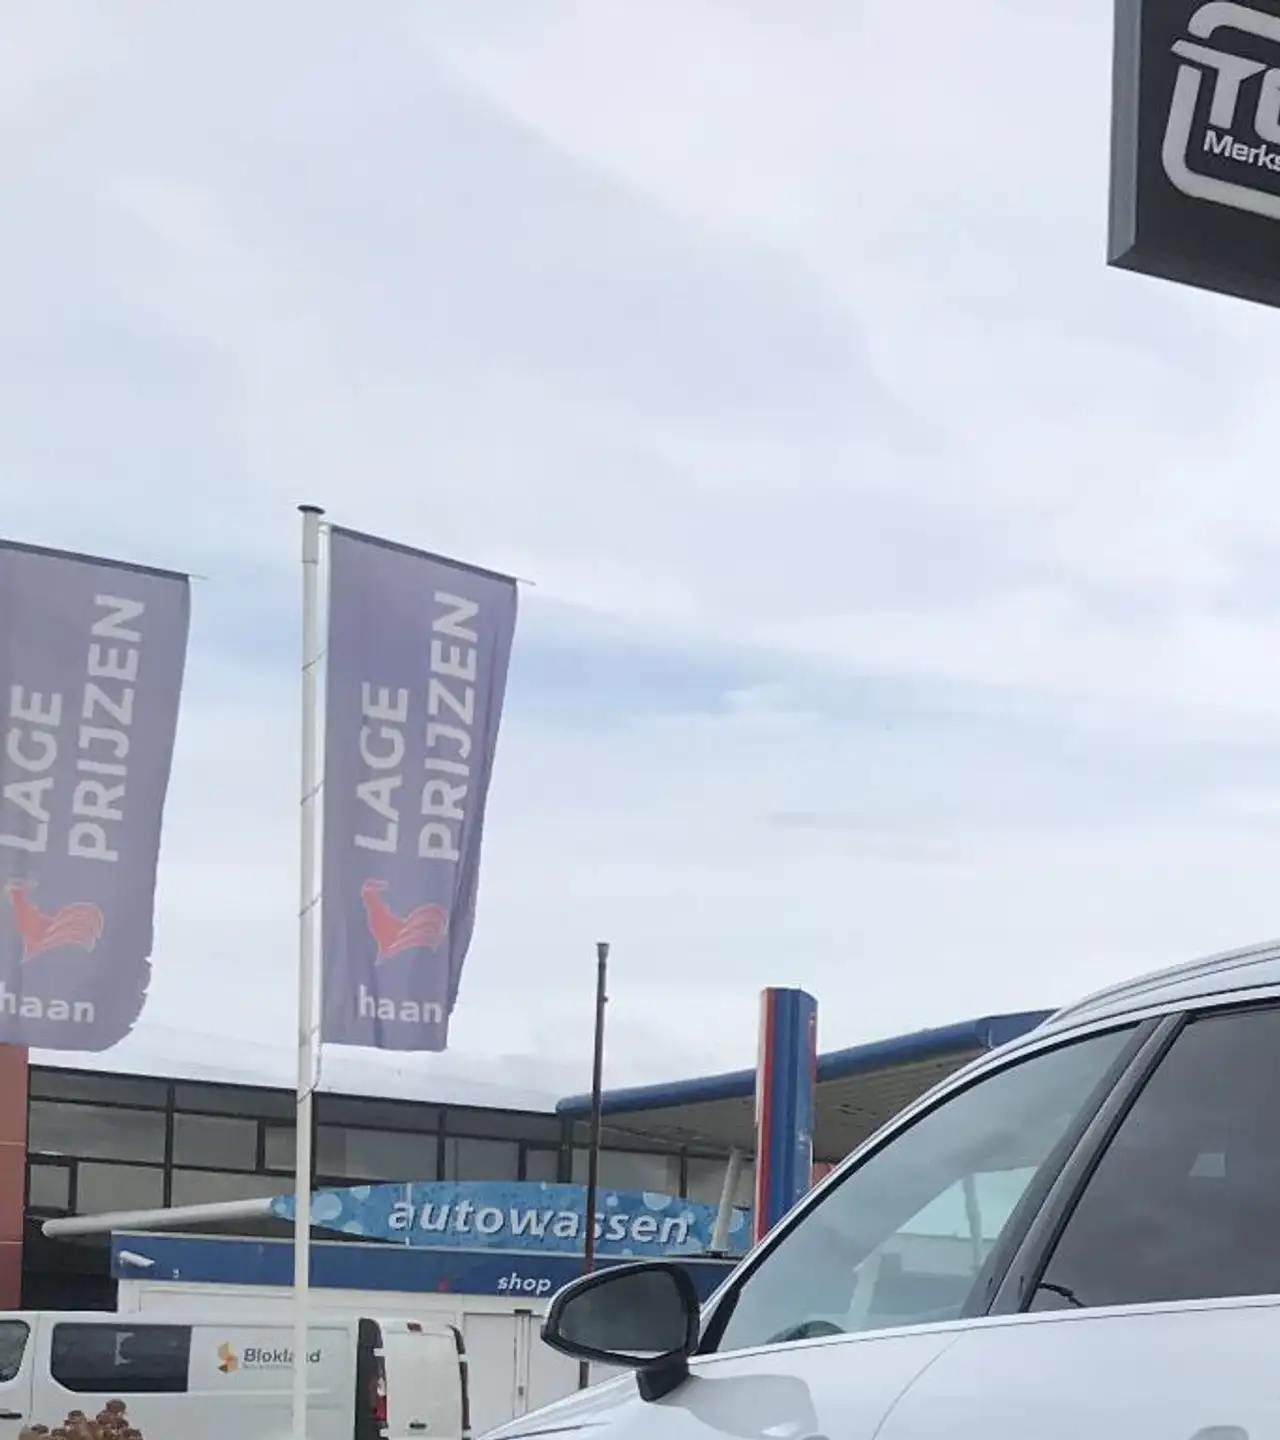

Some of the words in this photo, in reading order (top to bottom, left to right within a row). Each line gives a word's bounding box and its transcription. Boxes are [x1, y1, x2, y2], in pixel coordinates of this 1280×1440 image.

[0, 684, 63, 853] LAGE
[68, 594, 145, 863] PRIJZEN
[354, 681, 409, 854] LAGE
[418, 590, 479, 862] PRIJZEN
[0, 981, 95, 1023] haan
[359, 983, 442, 1023] haan
[388, 1198, 689, 1244] autowassen
[497, 1271, 551, 1296] shop
